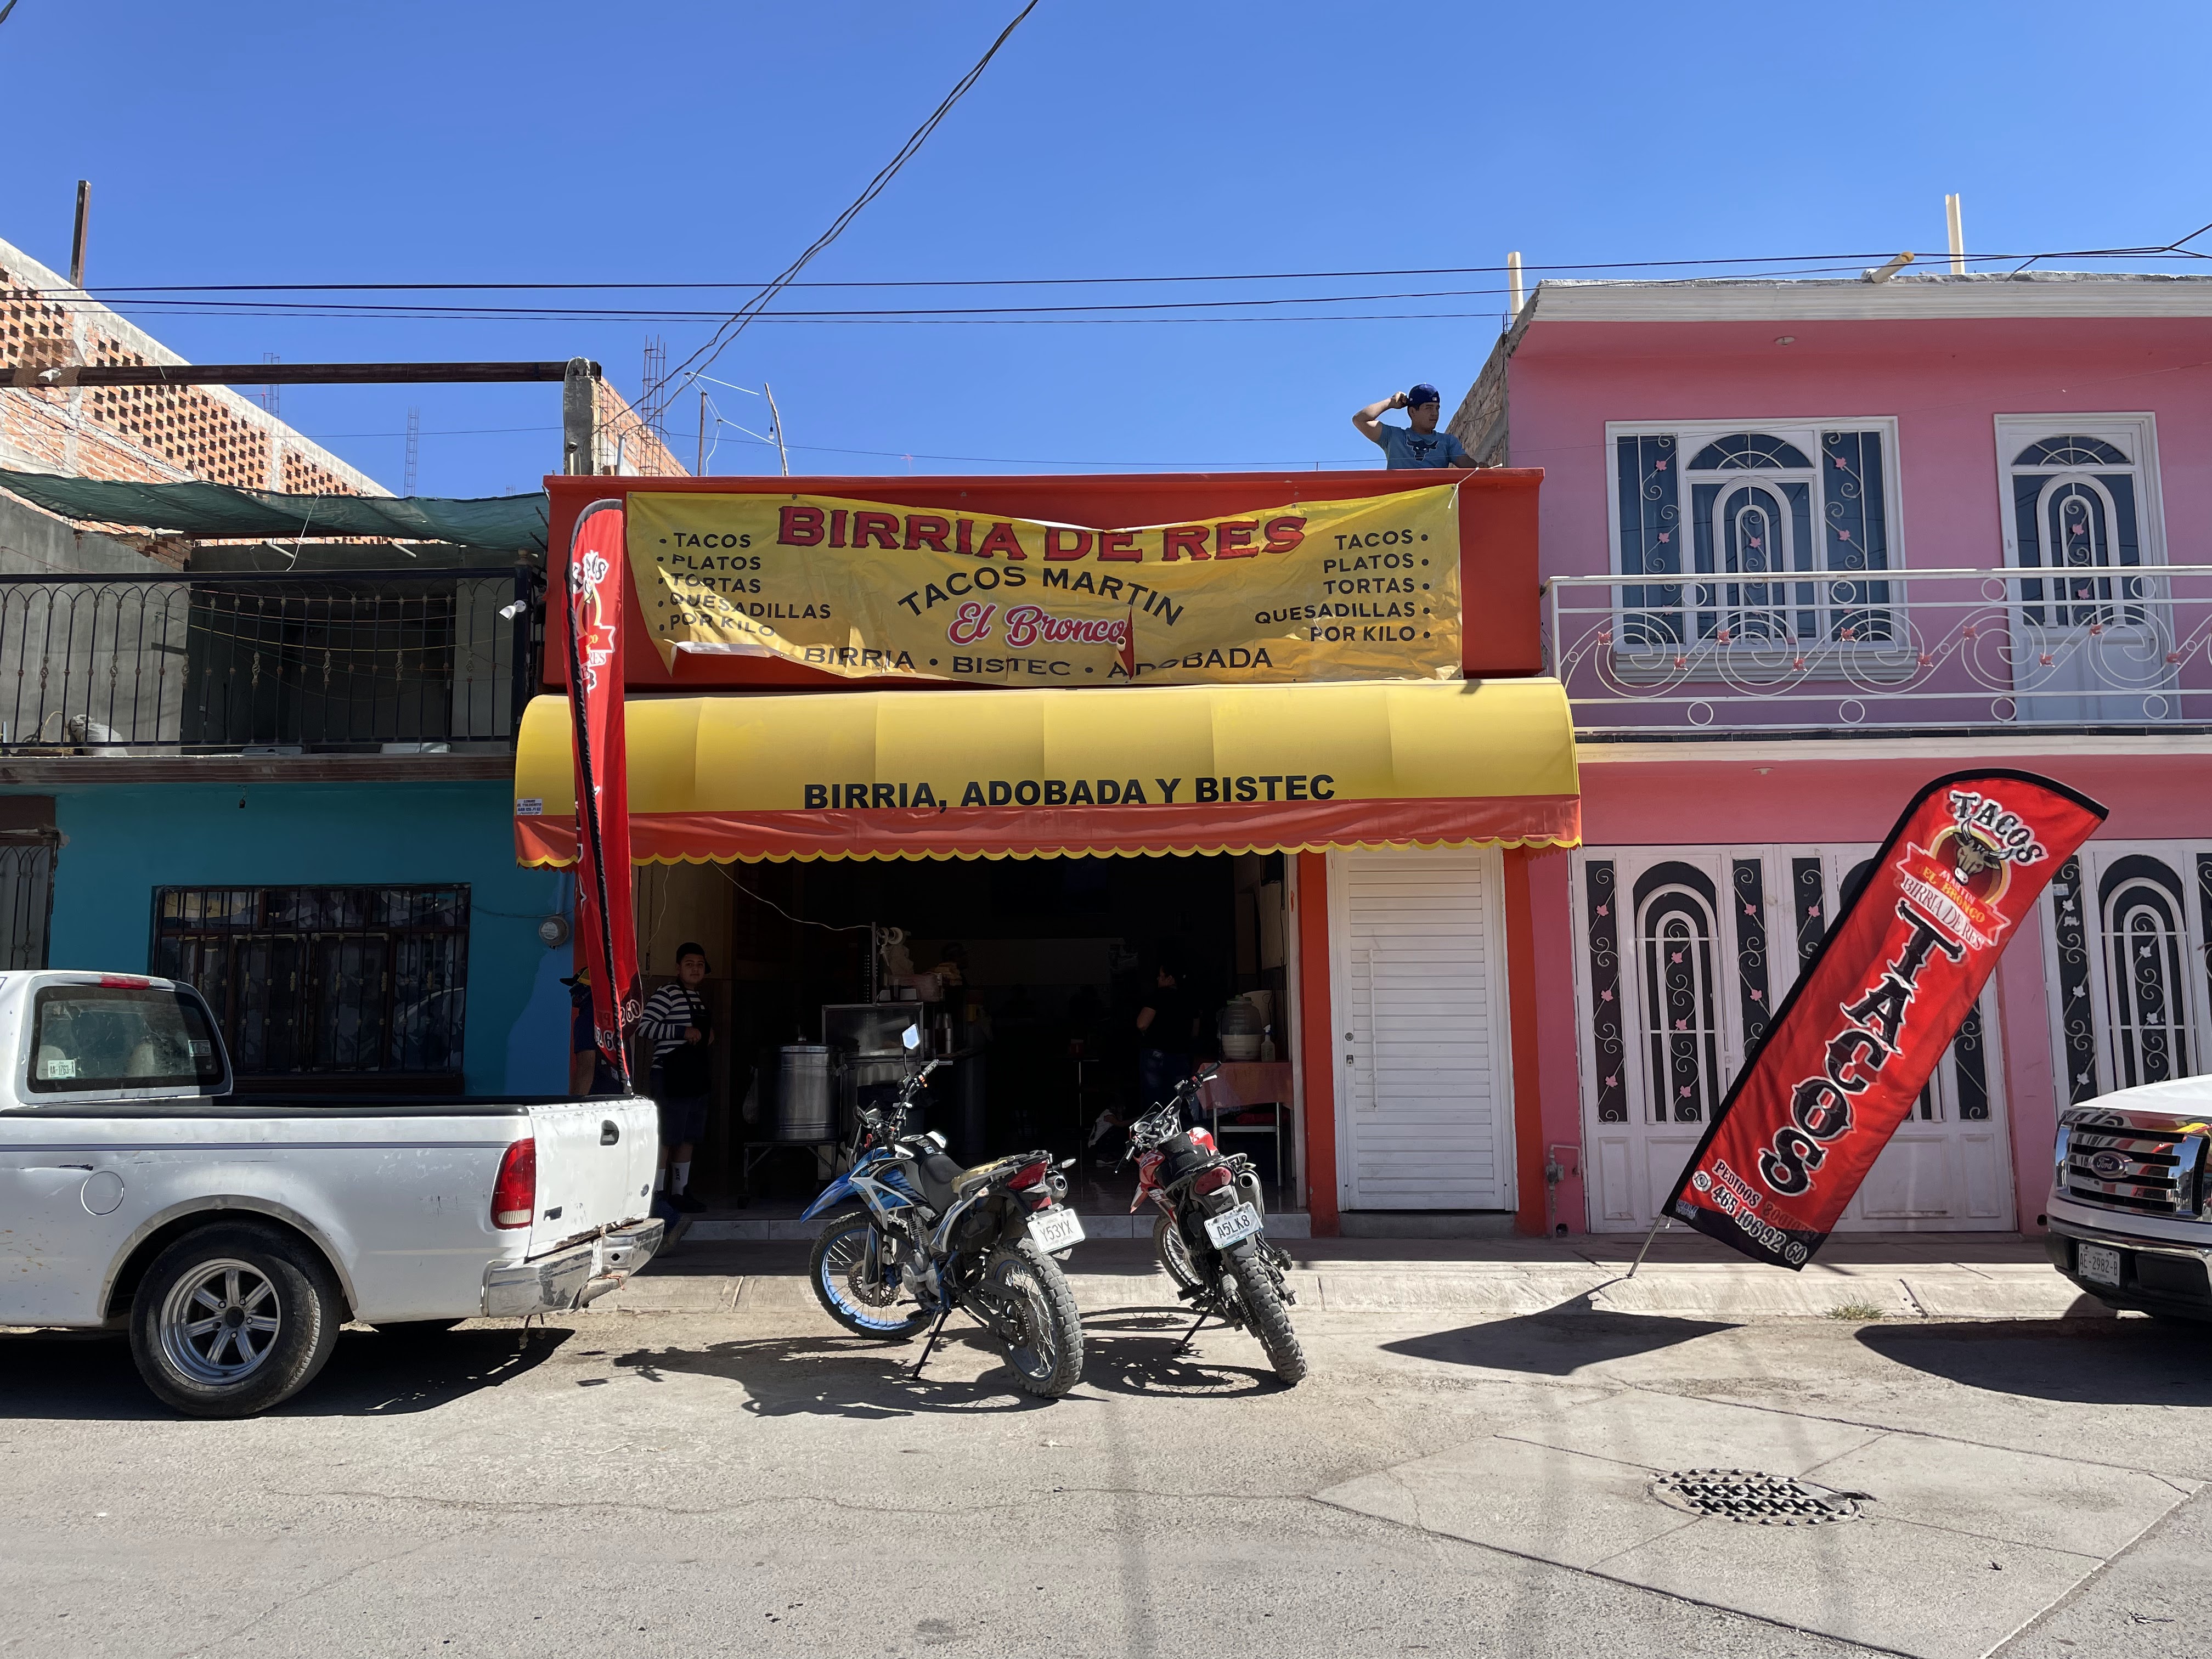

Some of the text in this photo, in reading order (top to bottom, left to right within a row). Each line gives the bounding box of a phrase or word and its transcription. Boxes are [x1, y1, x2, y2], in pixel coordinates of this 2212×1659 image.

[673, 532, 751, 548] TACOS
[776, 506, 1308, 563] BIRRIA DE RES
[1334, 529, 1413, 550] TACOS
[672, 554, 761, 571] PLATOS
[1323, 553, 1414, 573] PLATOS
[672, 573, 761, 594] TORTAS
[1323, 578, 1415, 595] TORTAS
[670, 591, 831, 619] QUESADILLAS
[898, 566, 1184, 627] TACOS MARTIN
[670, 612, 775, 636] POR KILO
[948, 601, 1127, 648] El Bronco
[1255, 602, 1415, 624] QUESADILLAS
[1311, 625, 1415, 642] POR KILO
[803, 647, 916, 670] BIRRIA
[952, 656, 1071, 676] BISTEC
[804, 774, 1335, 813] BIRRIA, ADOBADA Y BISTEC
[1950, 792, 2046, 865] TACOS
[1922, 866, 1986, 923] EL BRONCO
[1903, 877, 1983, 950] BIRRIA DE RES
[1759, 898, 1965, 1197] TACOS
[2096, 1156, 2114, 1170] Ford
[1713, 1160, 1761, 1207] PEDIDOS
[1040, 1220, 1074, 1242] Y53YX
[1216, 1215, 1250, 1239] A5LK8
[1712, 1185, 1739, 1215] 465
[1736, 1207, 1763, 1237] 106
[1759, 1227, 1786, 1253] 92
[1786, 1241, 1807, 1264] 60
[2079, 1252, 2118, 1276] AE-2982-B
